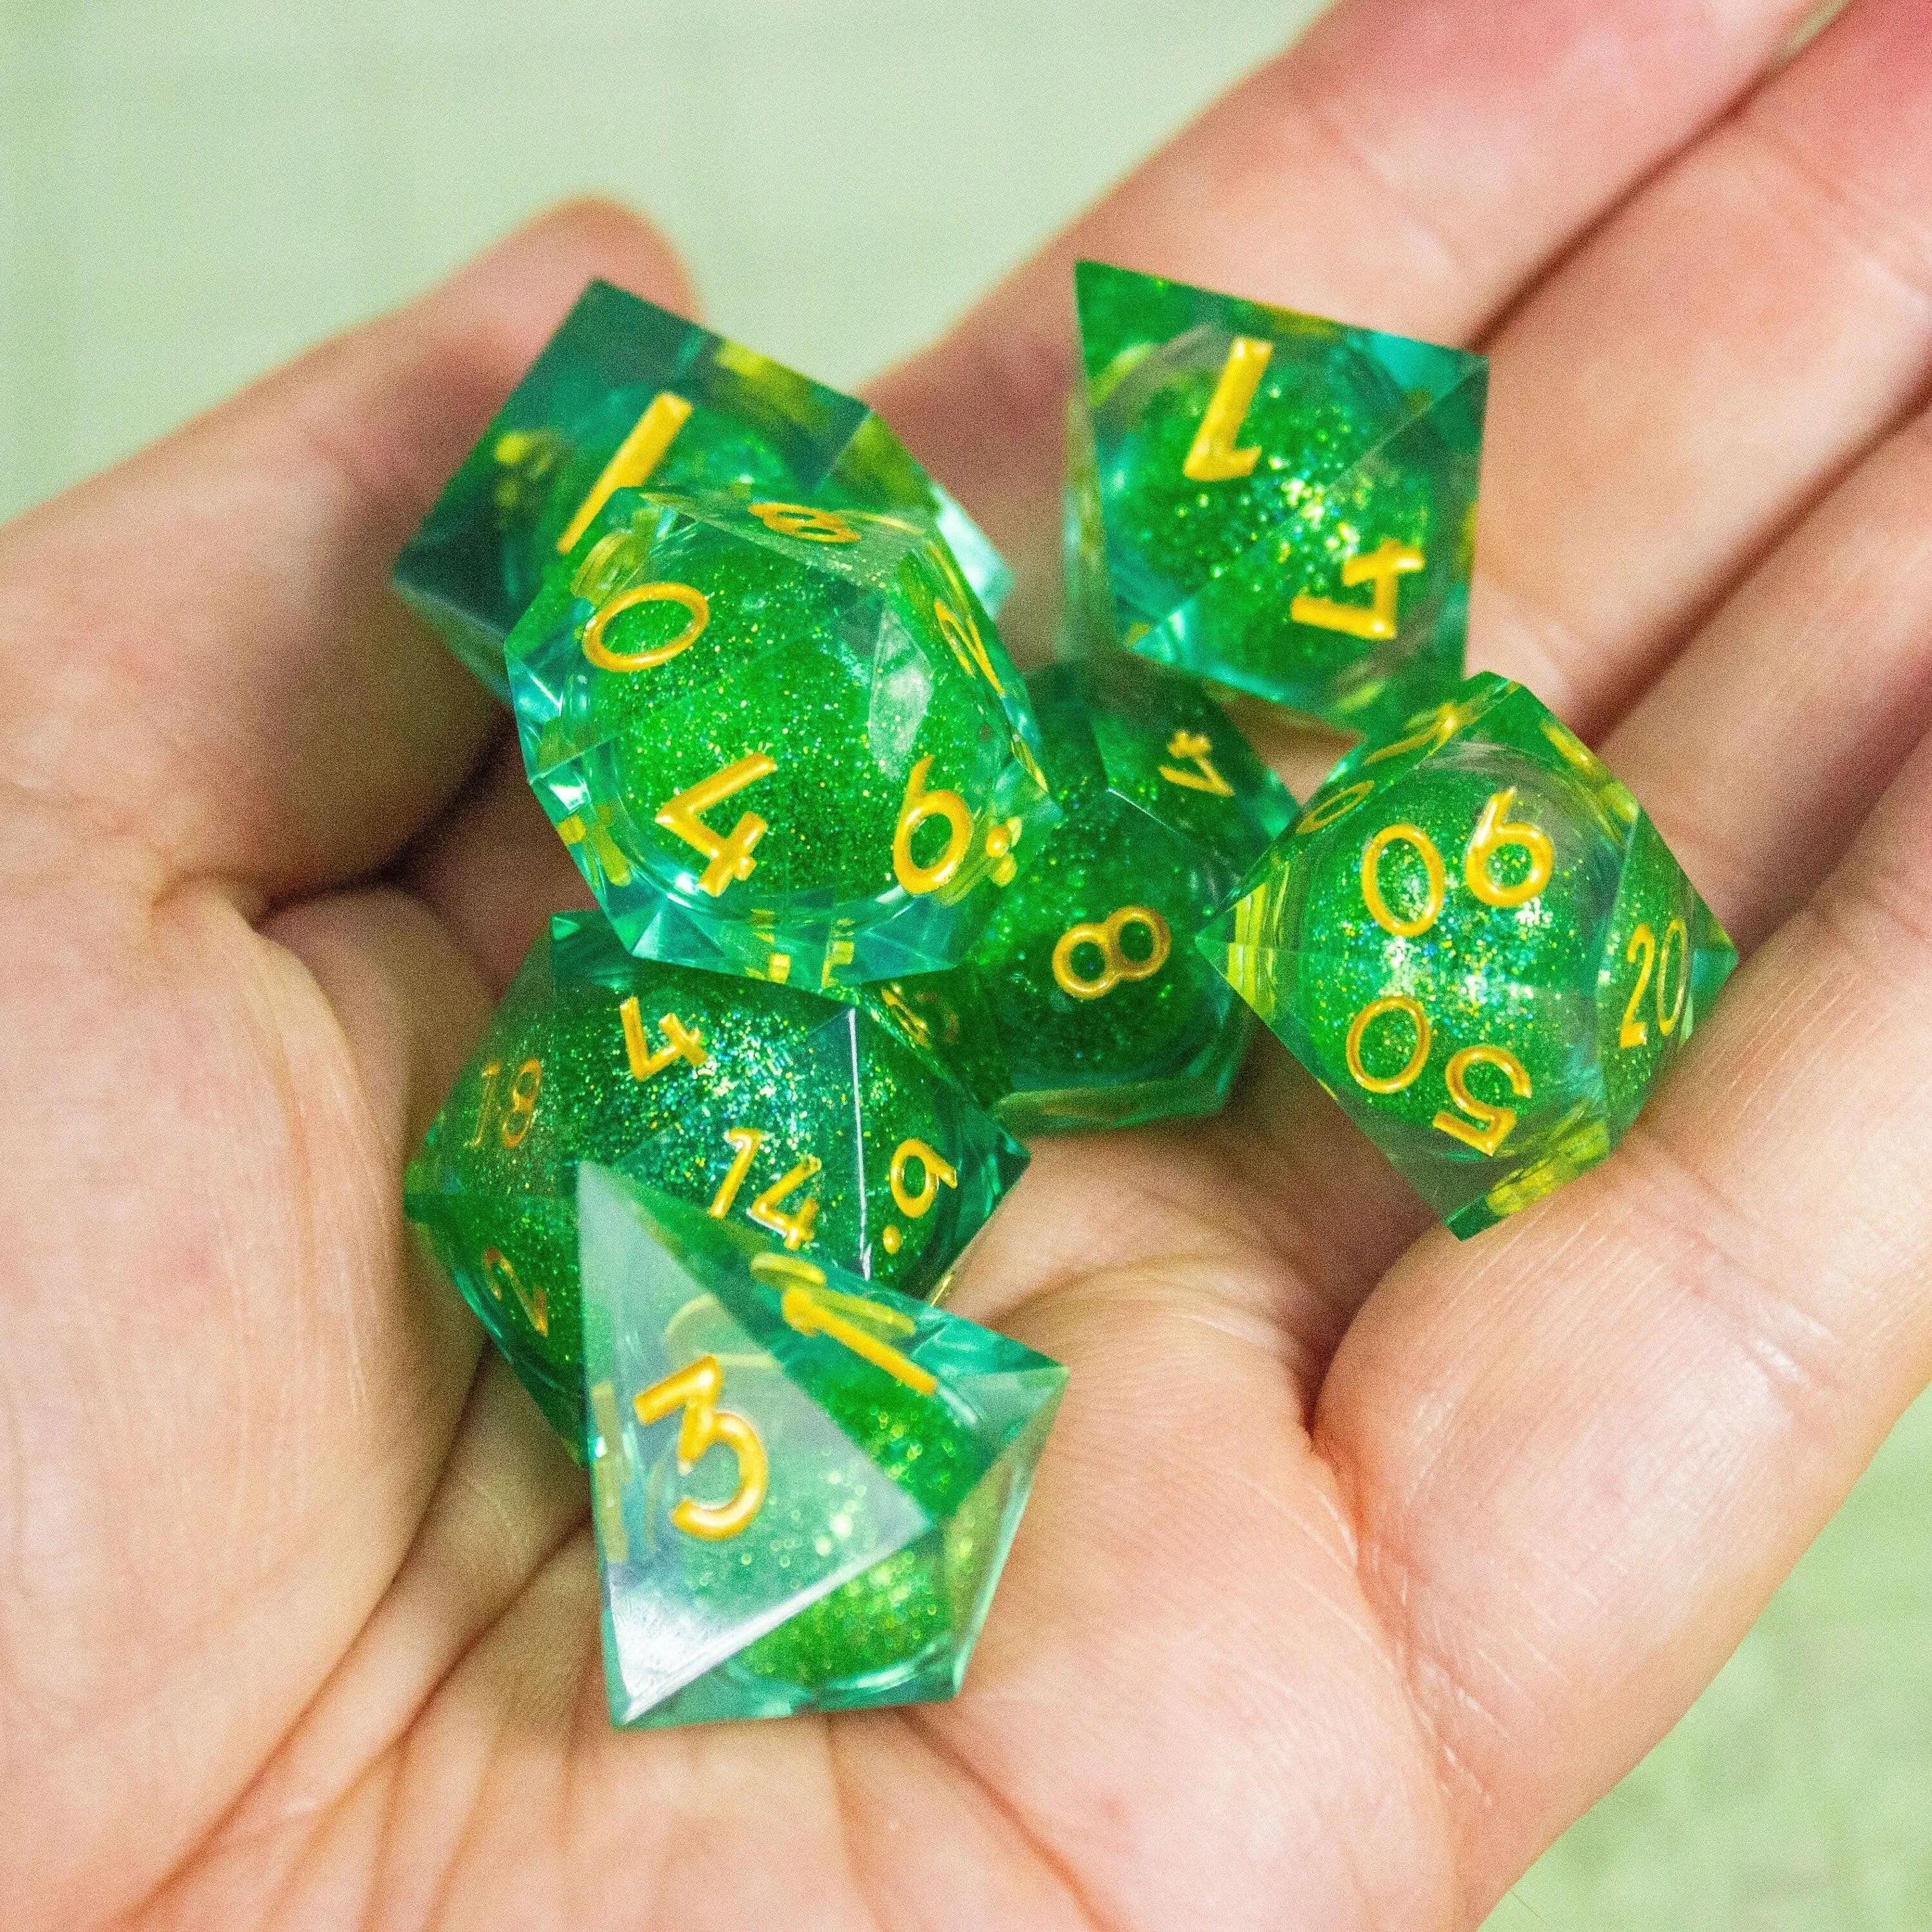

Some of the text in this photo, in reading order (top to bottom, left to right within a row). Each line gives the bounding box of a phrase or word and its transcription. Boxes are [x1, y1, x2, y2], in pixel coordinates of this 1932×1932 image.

[748, 502, 861, 544] 8
[583, 581, 710, 673] 0
[1292, 538, 1424, 640] 4
[1158, 729, 1235, 798] 4
[655, 750, 778, 898] 4
[1052, 905, 1172, 1000] 8
[1619, 919, 1687, 1050] 20
[619, 997, 708, 1082] 4
[1346, 995, 1534, 1156] 50
[464, 1058, 542, 1149] 18
[709, 1127, 822, 1251] 14
[634, 1354, 769, 1539] 3
